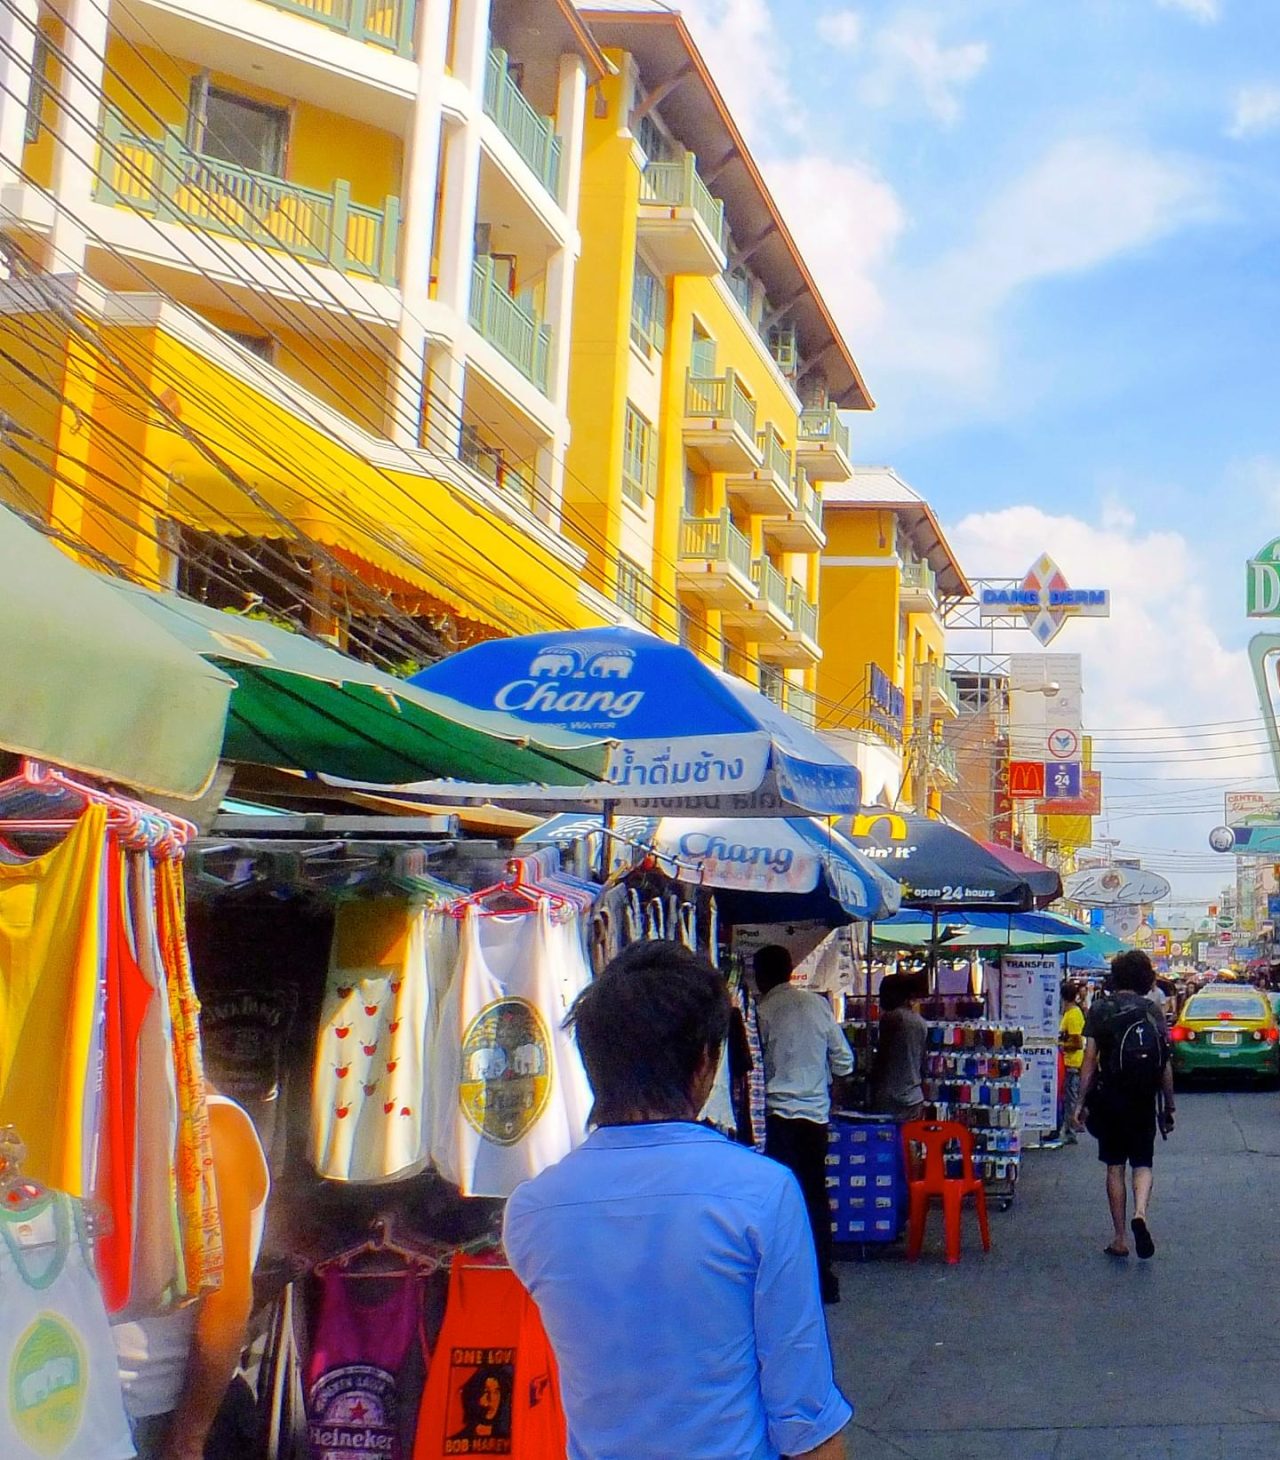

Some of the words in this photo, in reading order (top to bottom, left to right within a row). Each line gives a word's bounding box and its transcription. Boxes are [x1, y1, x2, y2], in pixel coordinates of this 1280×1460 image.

[495, 679, 646, 718] Chang
[570, 720, 617, 730] WATER
[1055, 775, 1070, 786] 24
[679, 832, 795, 873] Chang
[914, 889, 940, 899] open
[941, 886, 964, 900] 24
[965, 889, 996, 898] hours
[1006, 960, 1056, 970] TRANSFER
[454, 1349, 483, 1364] ONE
[446, 1438, 469, 1454] BOB
